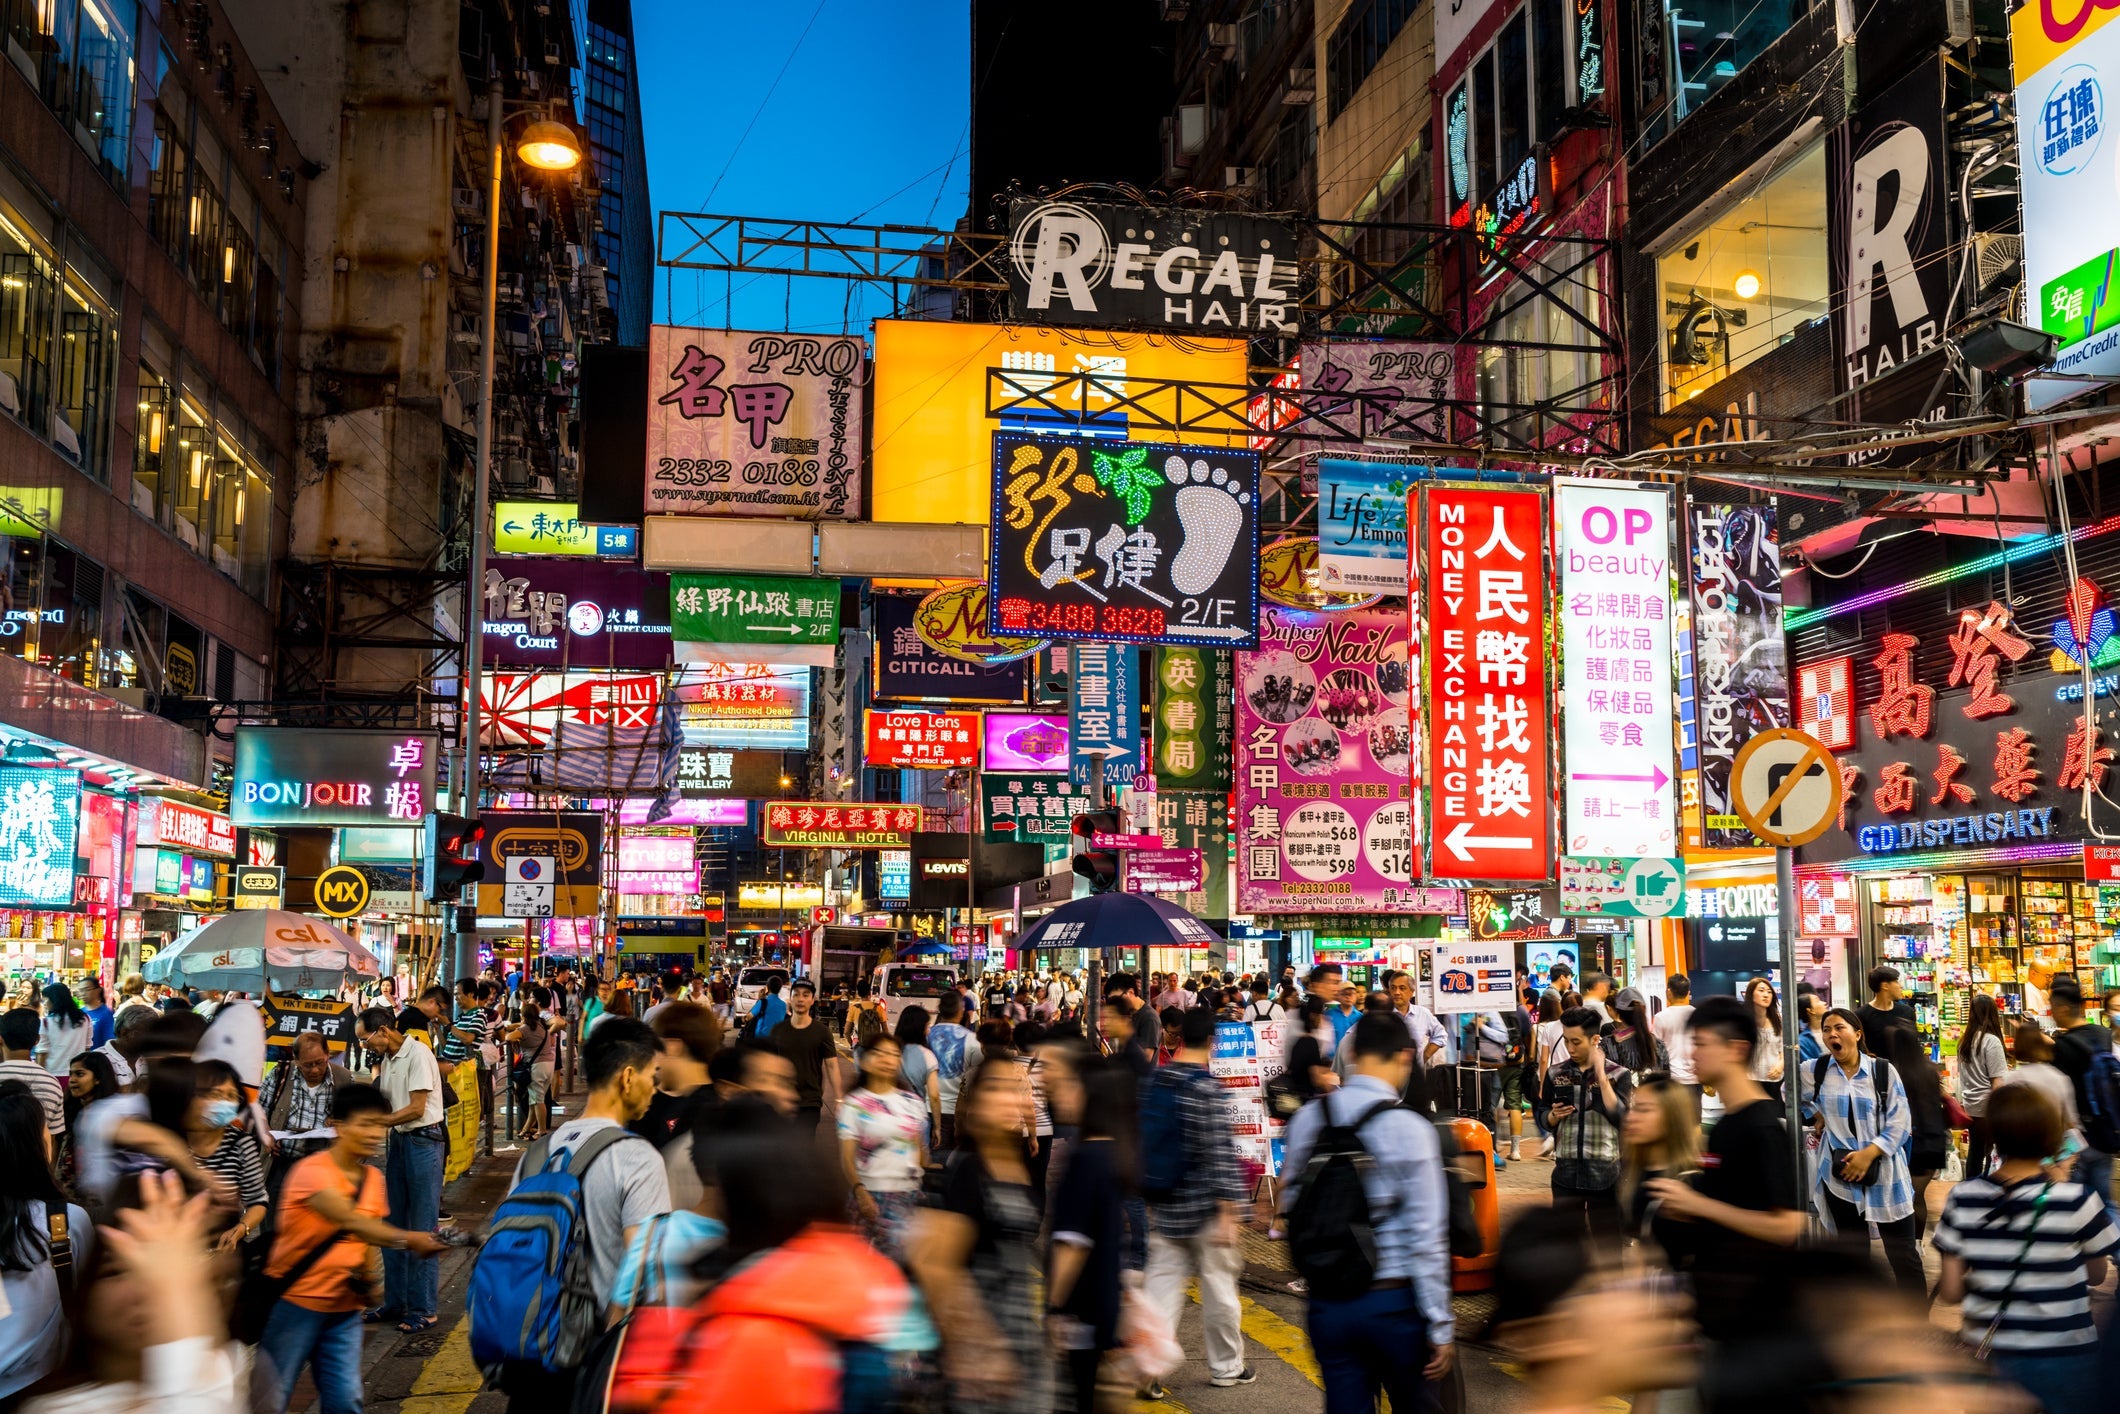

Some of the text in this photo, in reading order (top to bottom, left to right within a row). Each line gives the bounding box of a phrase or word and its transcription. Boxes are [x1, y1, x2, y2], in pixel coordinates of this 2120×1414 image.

[2044, 77, 2096, 141] 任揀
[2042, 115, 2099, 167] 迎新禮品
[1027, 215, 1288, 312] REGAL
[1164, 297, 1294, 330] HAIR
[2050, 285, 2085, 323] 安信
[748, 336, 860, 377] PRO
[1370, 350, 1454, 380] PRO
[1847, 318, 1940, 390] HAIR
[1000, 350, 1128, 403] 豐澤
[658, 344, 795, 450] 名甲
[771, 436, 820, 456] 旗艦店
[655, 457, 821, 487] 2332 0188
[652, 487, 821, 507] www.supernail.com.hk
[1326, 483, 1378, 546] Life
[1581, 505, 1653, 546] OP
[529, 511, 589, 541] 東大門
[603, 534, 628, 548] 5樓
[1040, 523, 1174, 609] 足健
[1569, 548, 1665, 582] beauty
[607, 608, 639, 625] 火鍋
[1180, 598, 1236, 625] 2/F
[1569, 592, 1665, 620] 名牌開倉
[1031, 602, 1165, 635] 3488 3628
[809, 624, 832, 637] 2/F
[1261, 608, 1396, 665] Super Nail
[1586, 624, 1652, 651] 化妝品
[516, 635, 558, 649] Court
[888, 660, 976, 676] CITICALL
[1440, 503, 1468, 817] MONEY EXCHANGE
[1472, 505, 1532, 818] 人民幣找換
[1585, 656, 1653, 683] 護膚品
[590, 683, 650, 705] 美心
[701, 683, 778, 702] 攝影器材
[1586, 688, 1653, 715] 保健品
[589, 704, 650, 726] MX
[688, 704, 794, 717] Nikon Authorized Dealer
[1168, 657, 1197, 770] 英書局
[886, 715, 960, 729] Love Lens
[878, 728, 969, 743] 韓國隱形眼鏡
[1599, 721, 1644, 748] 零食
[891, 756, 911, 765] Korea
[912, 757, 939, 765] Contact
[959, 756, 973, 766] 3/F
[901, 743, 945, 757] 專門店
[680, 752, 734, 779] 珠寶
[1074, 763, 1136, 783] 14:-24:00
[243, 781, 372, 808] BONJOUR
[677, 779, 734, 790] EWELLERY
[1281, 783, 1390, 799] 環境舒適 優質服務
[1248, 723, 1282, 882] 名甲集團
[1582, 797, 1661, 820] 請上一樓
[770, 805, 918, 831] 維珍尼亞賓館
[1376, 812, 1393, 825] Gel
[784, 830, 903, 843] VIRGINIA HOTEL
[1284, 830, 1306, 839] Manicure
[1331, 826, 1358, 841] $68
[2093, 847, 2120, 861] KICK
[1288, 858, 1305, 867] Pedicure
[1329, 859, 1356, 874] $98
[323, 881, 360, 903] MX
[535, 885, 545, 898] 7
[1282, 883, 1351, 895] Tel:2332 0188
[1383, 888, 1414, 904] 請上
[535, 904, 551, 916] 12
[1267, 895, 1366, 907] www.SuperNail.com.hk
[275, 924, 331, 944] csl.
[1369, 918, 1410, 929] 信心保證
[1527, 926, 1550, 938] 2/F
[212, 951, 235, 967] csl.
[1445, 972, 1467, 990] 78
[282, 1000, 302, 1008] HKT
[279, 1014, 340, 1036] 網上行
[1263, 1065, 1284, 1077] $68
